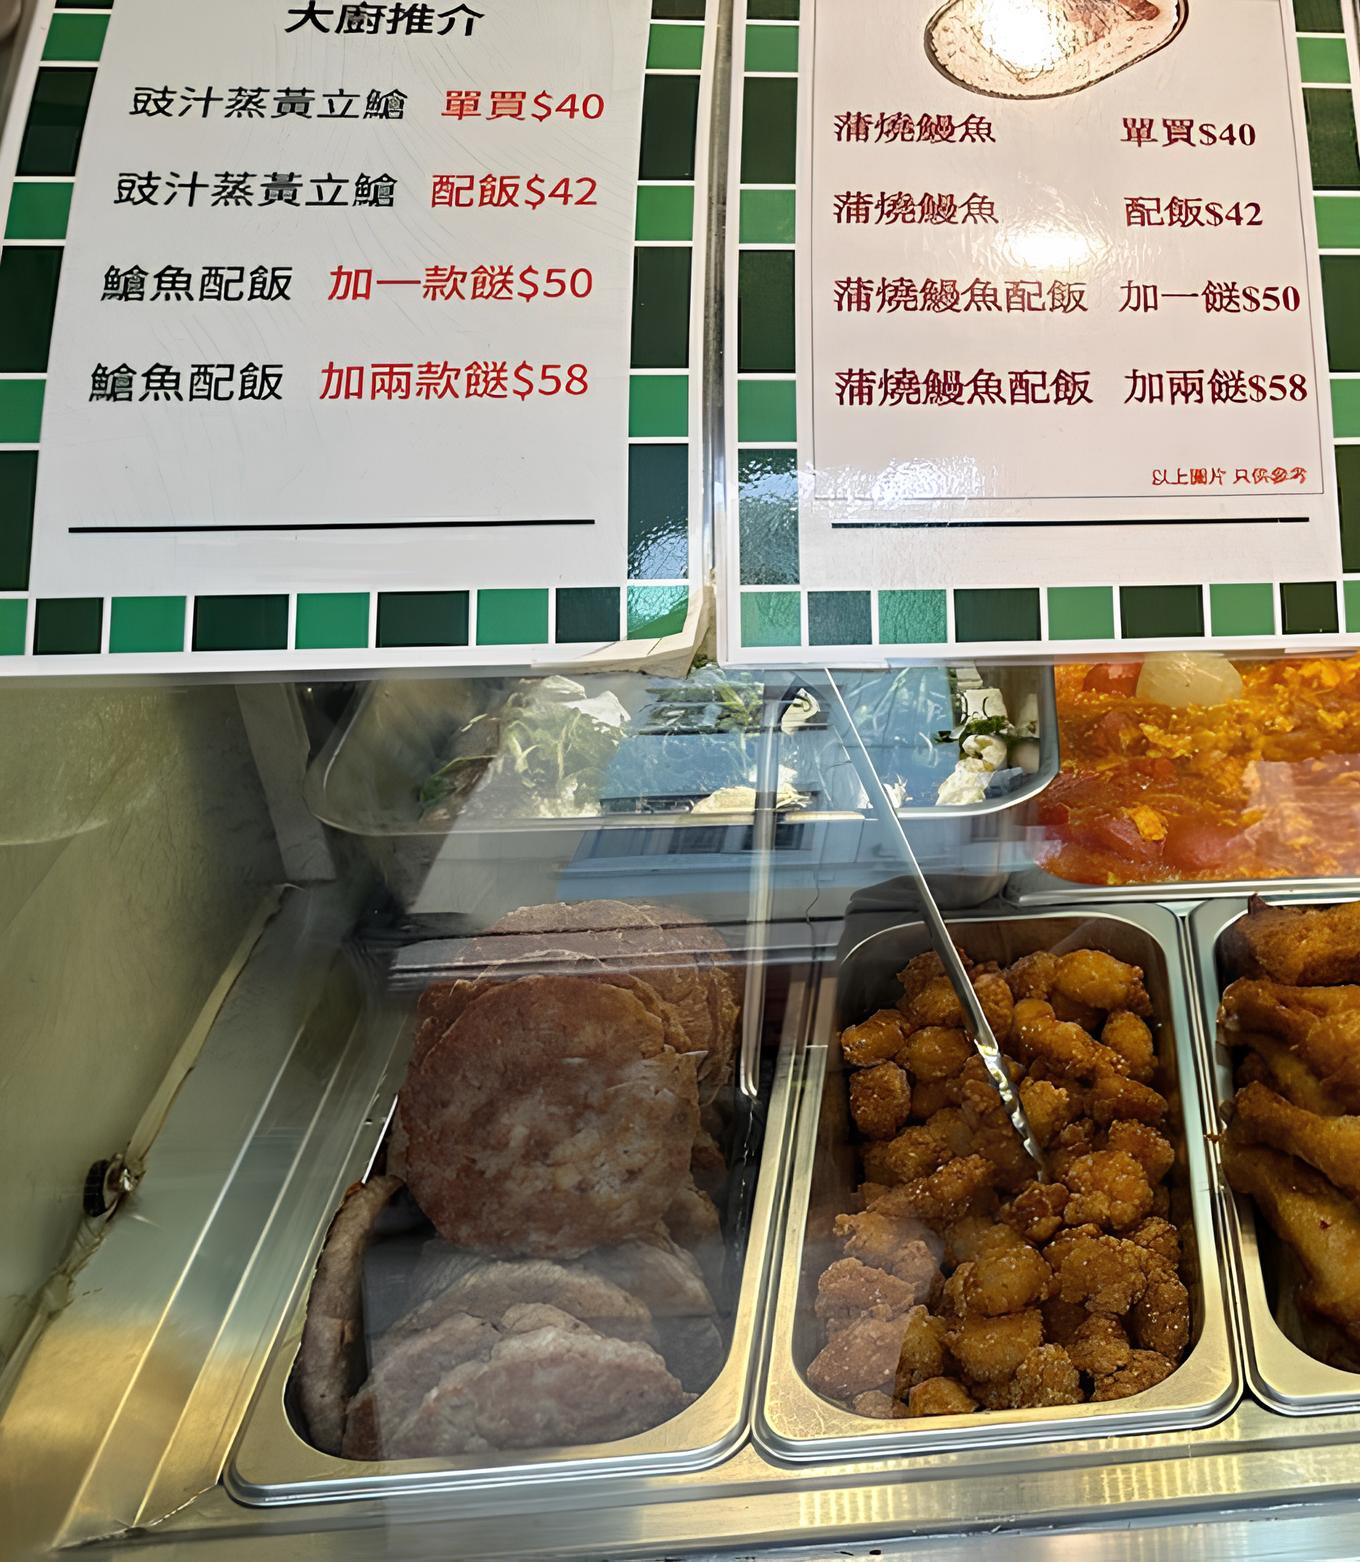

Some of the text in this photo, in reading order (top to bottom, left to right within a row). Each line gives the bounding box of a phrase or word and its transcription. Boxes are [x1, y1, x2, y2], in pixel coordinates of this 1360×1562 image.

[284, 0, 485, 36] 大廚推介
[441, 90, 604, 122] 單買$40
[834, 111, 1255, 147] 蒲燒鰻魚 單買$40
[432, 173, 597, 210] 配飯$42
[833, 191, 1263, 227] 蒲燒鰻魚 配飯$42
[328, 265, 592, 303] 加一款餸$50
[834, 277, 1300, 313] 蒲燒鰻魚配飯 加一餸$50
[319, 360, 588, 401] 加兩款餸$58
[835, 367, 1307, 406] 蒲燒鰻魚配飯 加兩餸$58
